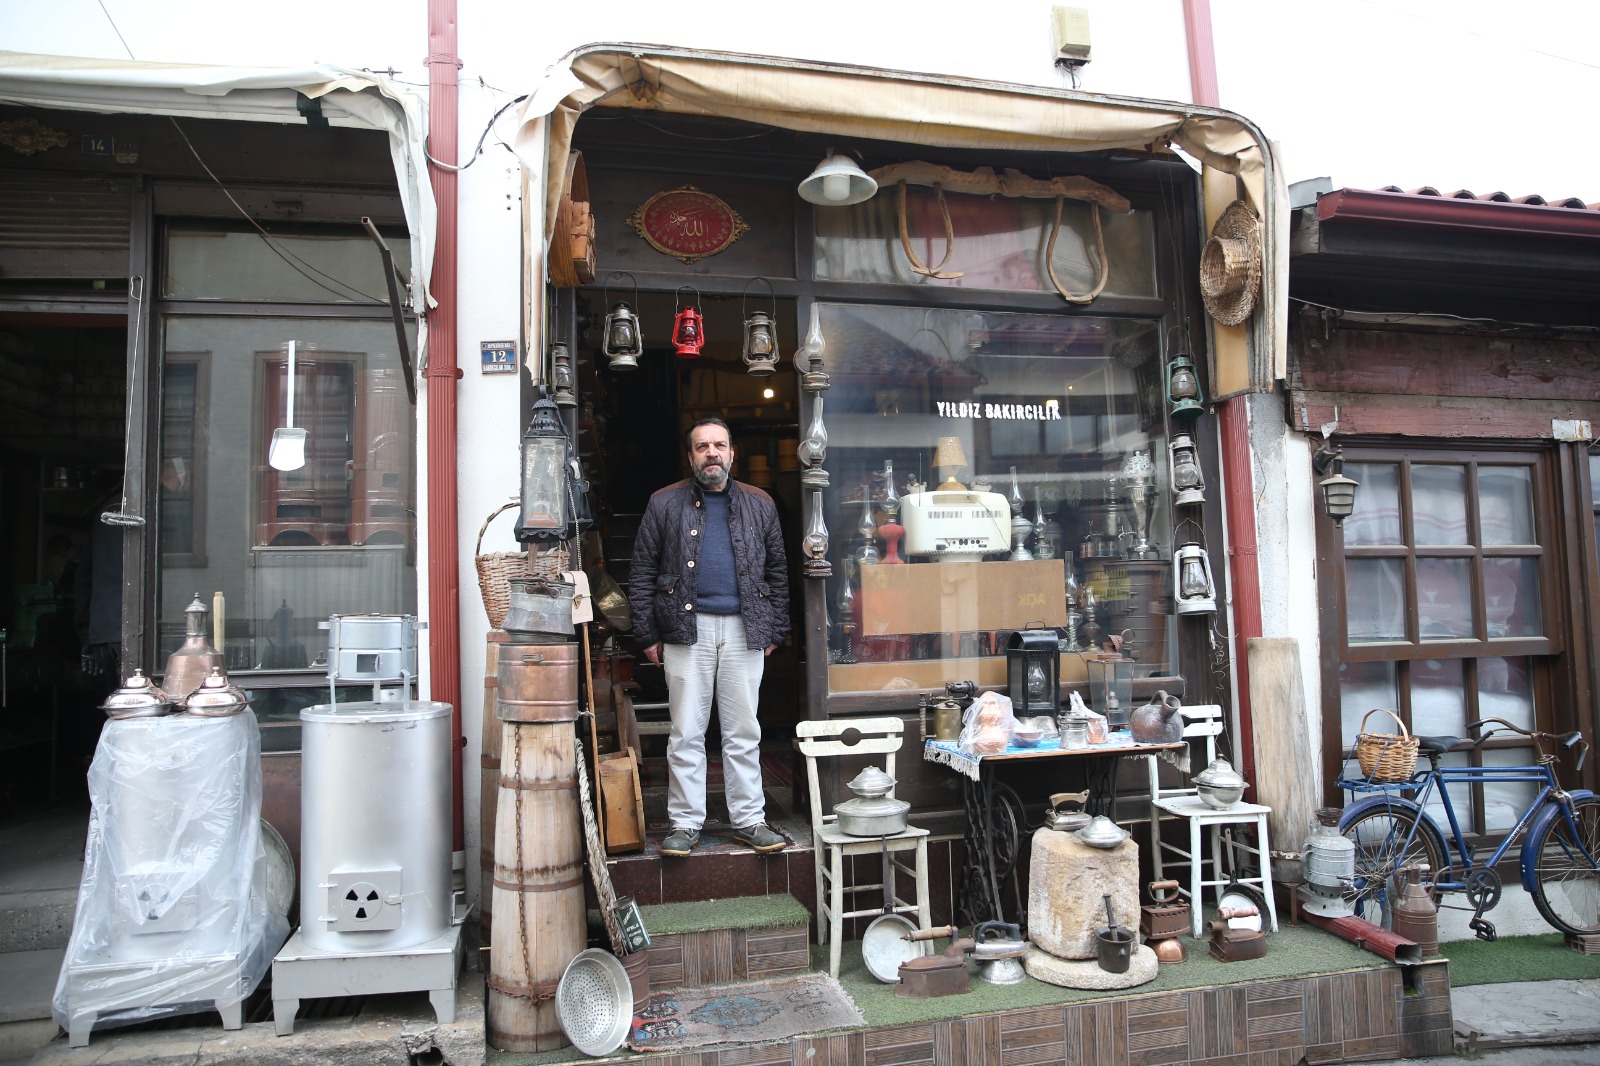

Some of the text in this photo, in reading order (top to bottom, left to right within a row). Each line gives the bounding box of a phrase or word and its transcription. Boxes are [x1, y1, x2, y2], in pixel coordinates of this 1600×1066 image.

[91, 139, 105, 151] 14
[491, 351, 507, 363] 12
[937, 401, 982, 419] YILDIZ
